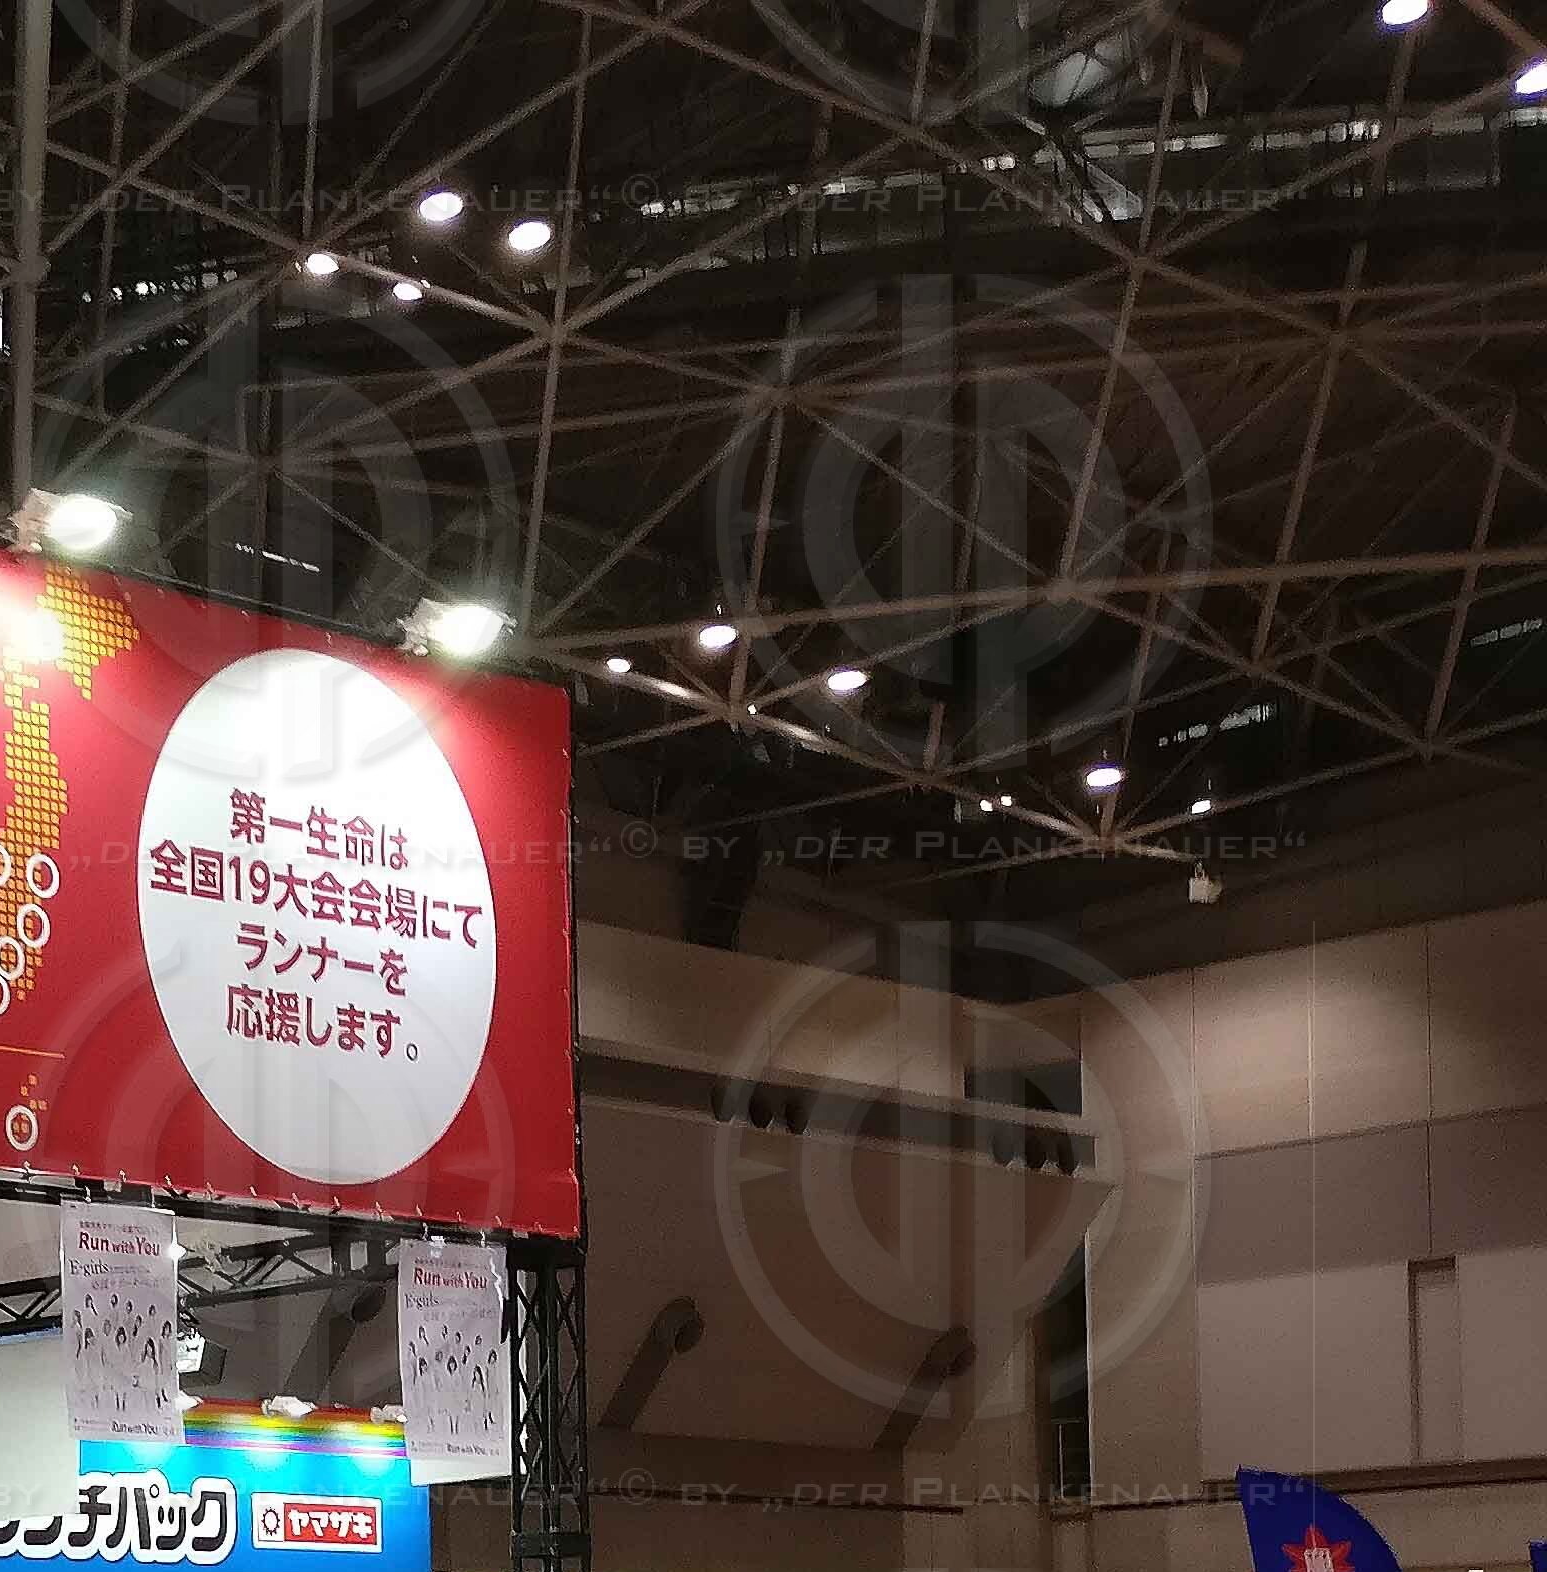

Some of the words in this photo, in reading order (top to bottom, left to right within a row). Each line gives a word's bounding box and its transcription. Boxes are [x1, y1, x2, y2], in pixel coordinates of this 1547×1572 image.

[229, 788, 409, 871] 第一生命は
[149, 838, 483, 949] 全国19大会会場にて
[237, 921, 408, 998] ランナーを
[226, 983, 420, 1062] 応援します。
[78, 1231, 110, 1254] Run
[135, 1237, 161, 1258] You
[412, 1267, 441, 1287] Run
[463, 1272, 488, 1291] You
[288, 1508, 374, 1539] ヤマザキ
